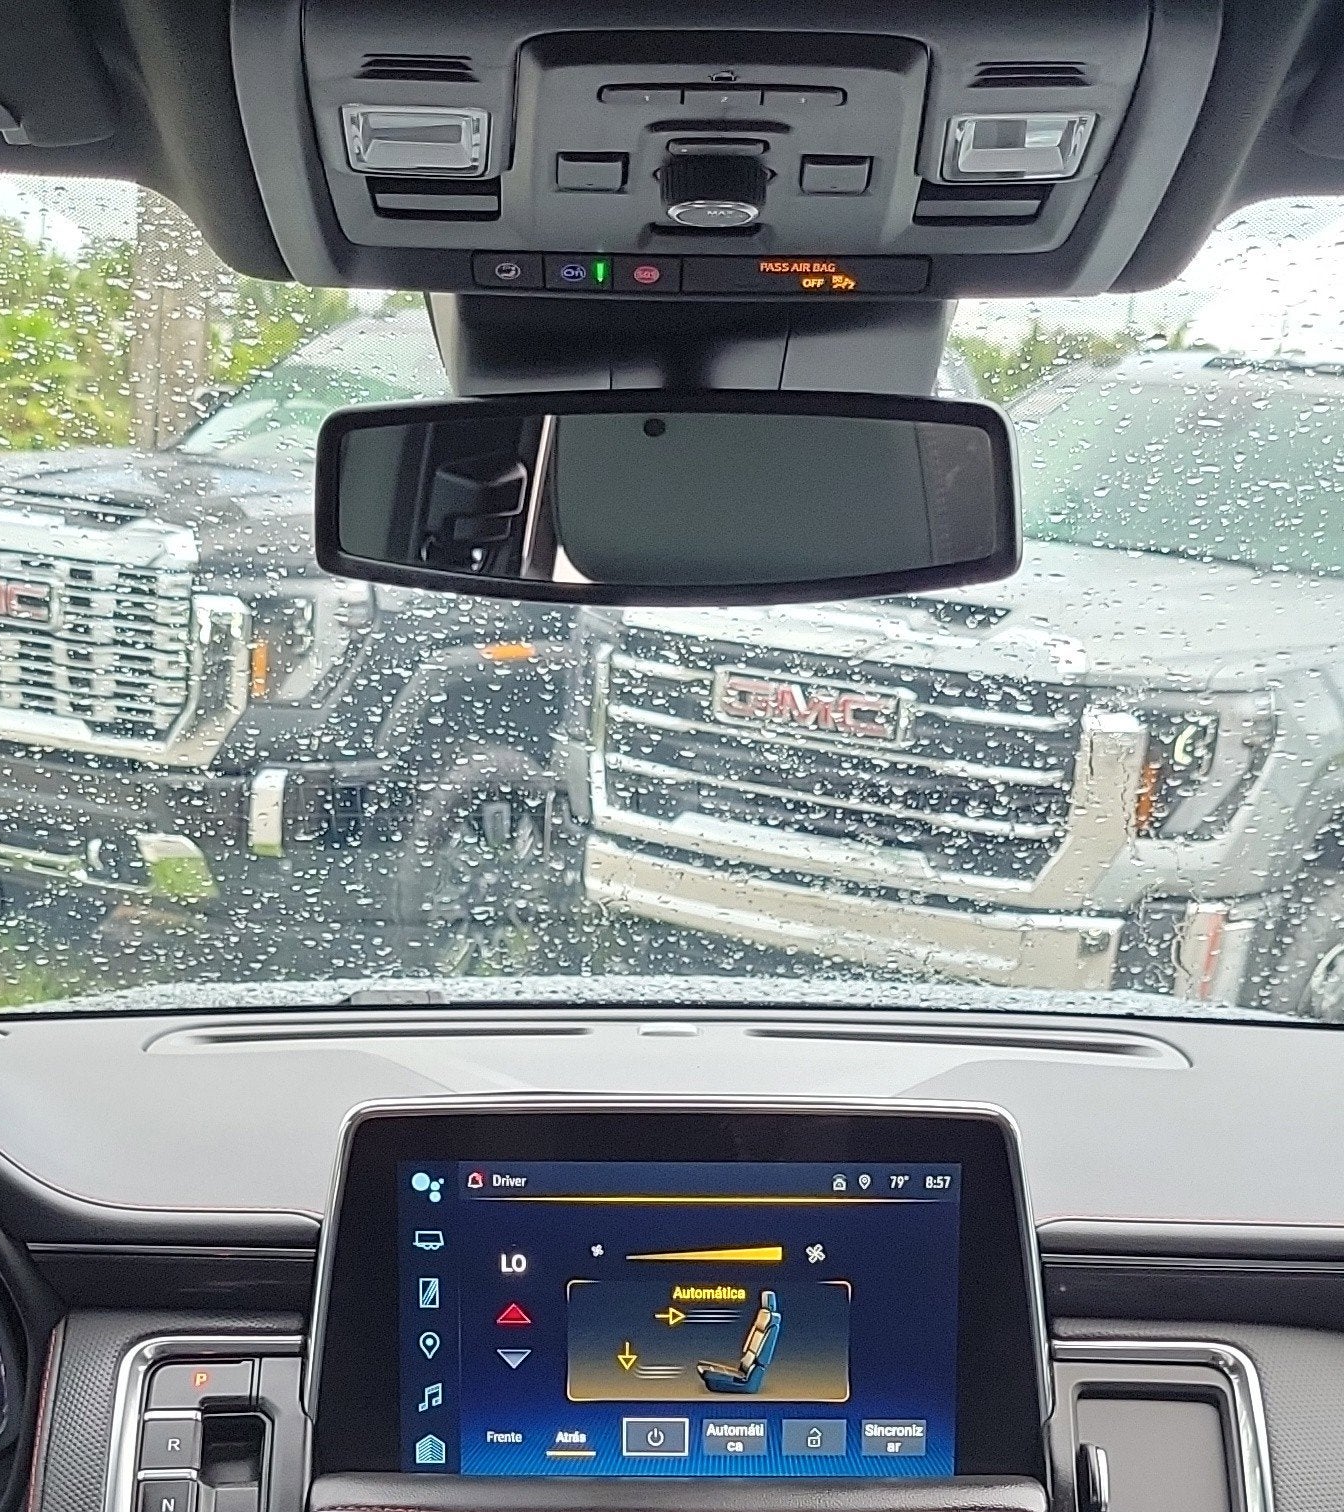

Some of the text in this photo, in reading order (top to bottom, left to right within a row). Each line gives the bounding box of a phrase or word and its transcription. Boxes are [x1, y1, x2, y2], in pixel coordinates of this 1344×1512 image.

[760, 262, 836, 274] PASS AIR BAG
[802, 278, 825, 289] OFF
[718, 673, 899, 739] GMC
[492, 1174, 527, 1189] Driver
[889, 1175, 910, 1189] 79°
[924, 1175, 952, 1189] 8:57
[500, 1253, 527, 1273] LO
[672, 1285, 747, 1300] Automática
[195, 1373, 208, 1388] P
[486, 1430, 523, 1445] Frente
[556, 1430, 588, 1444] Atrás
[705, 1423, 765, 1438] Automáti
[864, 1424, 924, 1438] Sincroniz
[167, 1438, 181, 1452] R
[727, 1441, 744, 1453] ca
[886, 1441, 903, 1453] ar
[161, 1498, 175, 1512] N
